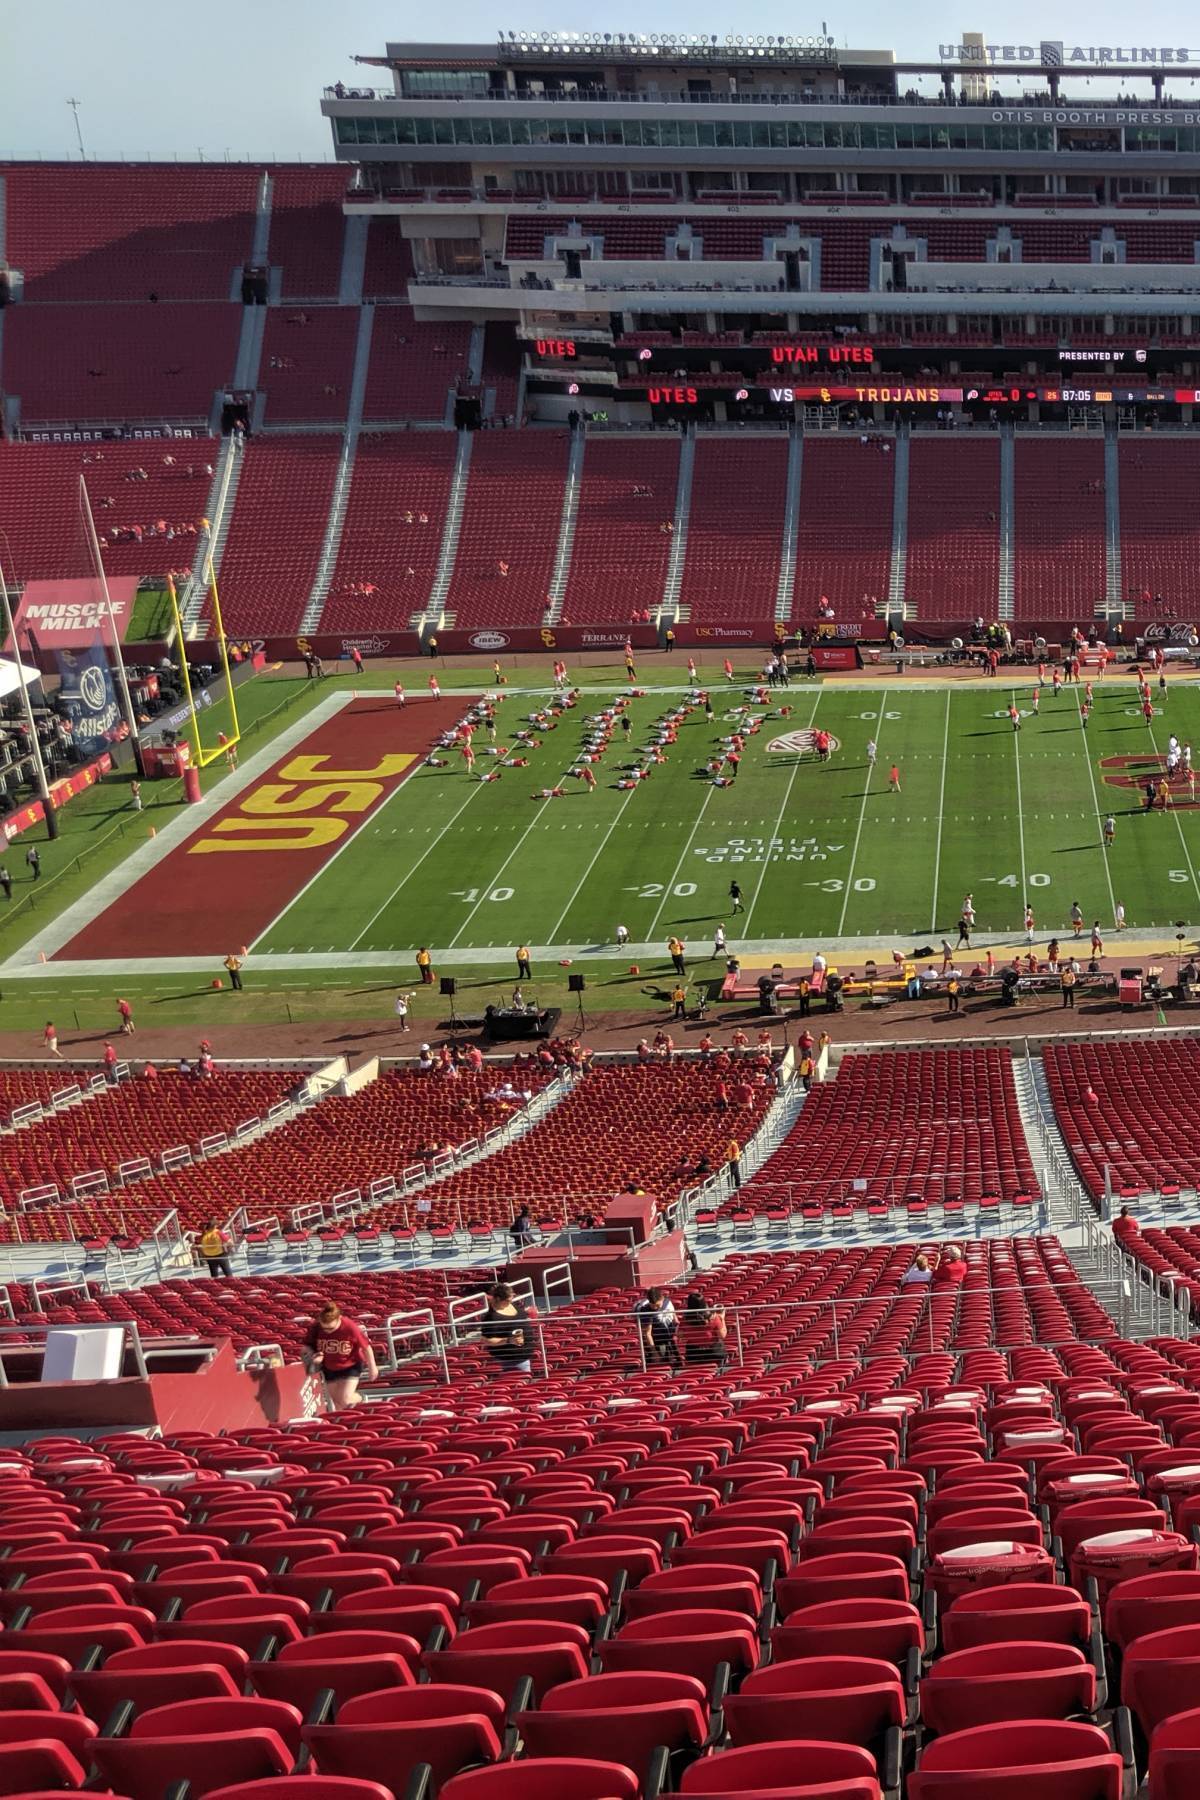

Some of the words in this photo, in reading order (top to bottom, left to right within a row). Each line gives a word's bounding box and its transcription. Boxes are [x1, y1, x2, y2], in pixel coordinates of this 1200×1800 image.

[939, 44, 1035, 60] UNITED
[1071, 46, 1190, 63] AIRLINES
[991, 111, 1033, 123] OTIS
[1043, 112, 1106, 124] BOOTH
[1116, 113, 1174, 125] PRESS
[536, 340, 576, 357] UTES
[772, 347, 818, 362] UTAH
[829, 348, 874, 362] UTES
[1059, 351, 1111, 361] PRESENTED
[1113, 351, 1125, 361] BY
[650, 388, 698, 403] UTES
[772, 388, 794, 402] VS
[856, 388, 940, 403] TROJANS
[1062, 390, 1091, 401] 87:05
[26, 601, 126, 618] MUSCLE
[40, 616, 104, 631] MILK
[836, 623, 862, 631] CREDIT
[1143, 622, 1196, 640] CocaCola
[715, 627, 754, 639] Pharmacy
[187, 753, 419, 854] USC
[727, 837, 817, 846] FIELD
[693, 844, 846, 855] AIRLINES
[705, 853, 827, 863] UNITED
[821, 878, 877, 892] 30
[998, 873, 1052, 888] 40
[460, 886, 516, 903] 10
[637, 882, 700, 898] 20
[316, 1339, 353, 1355] USC
